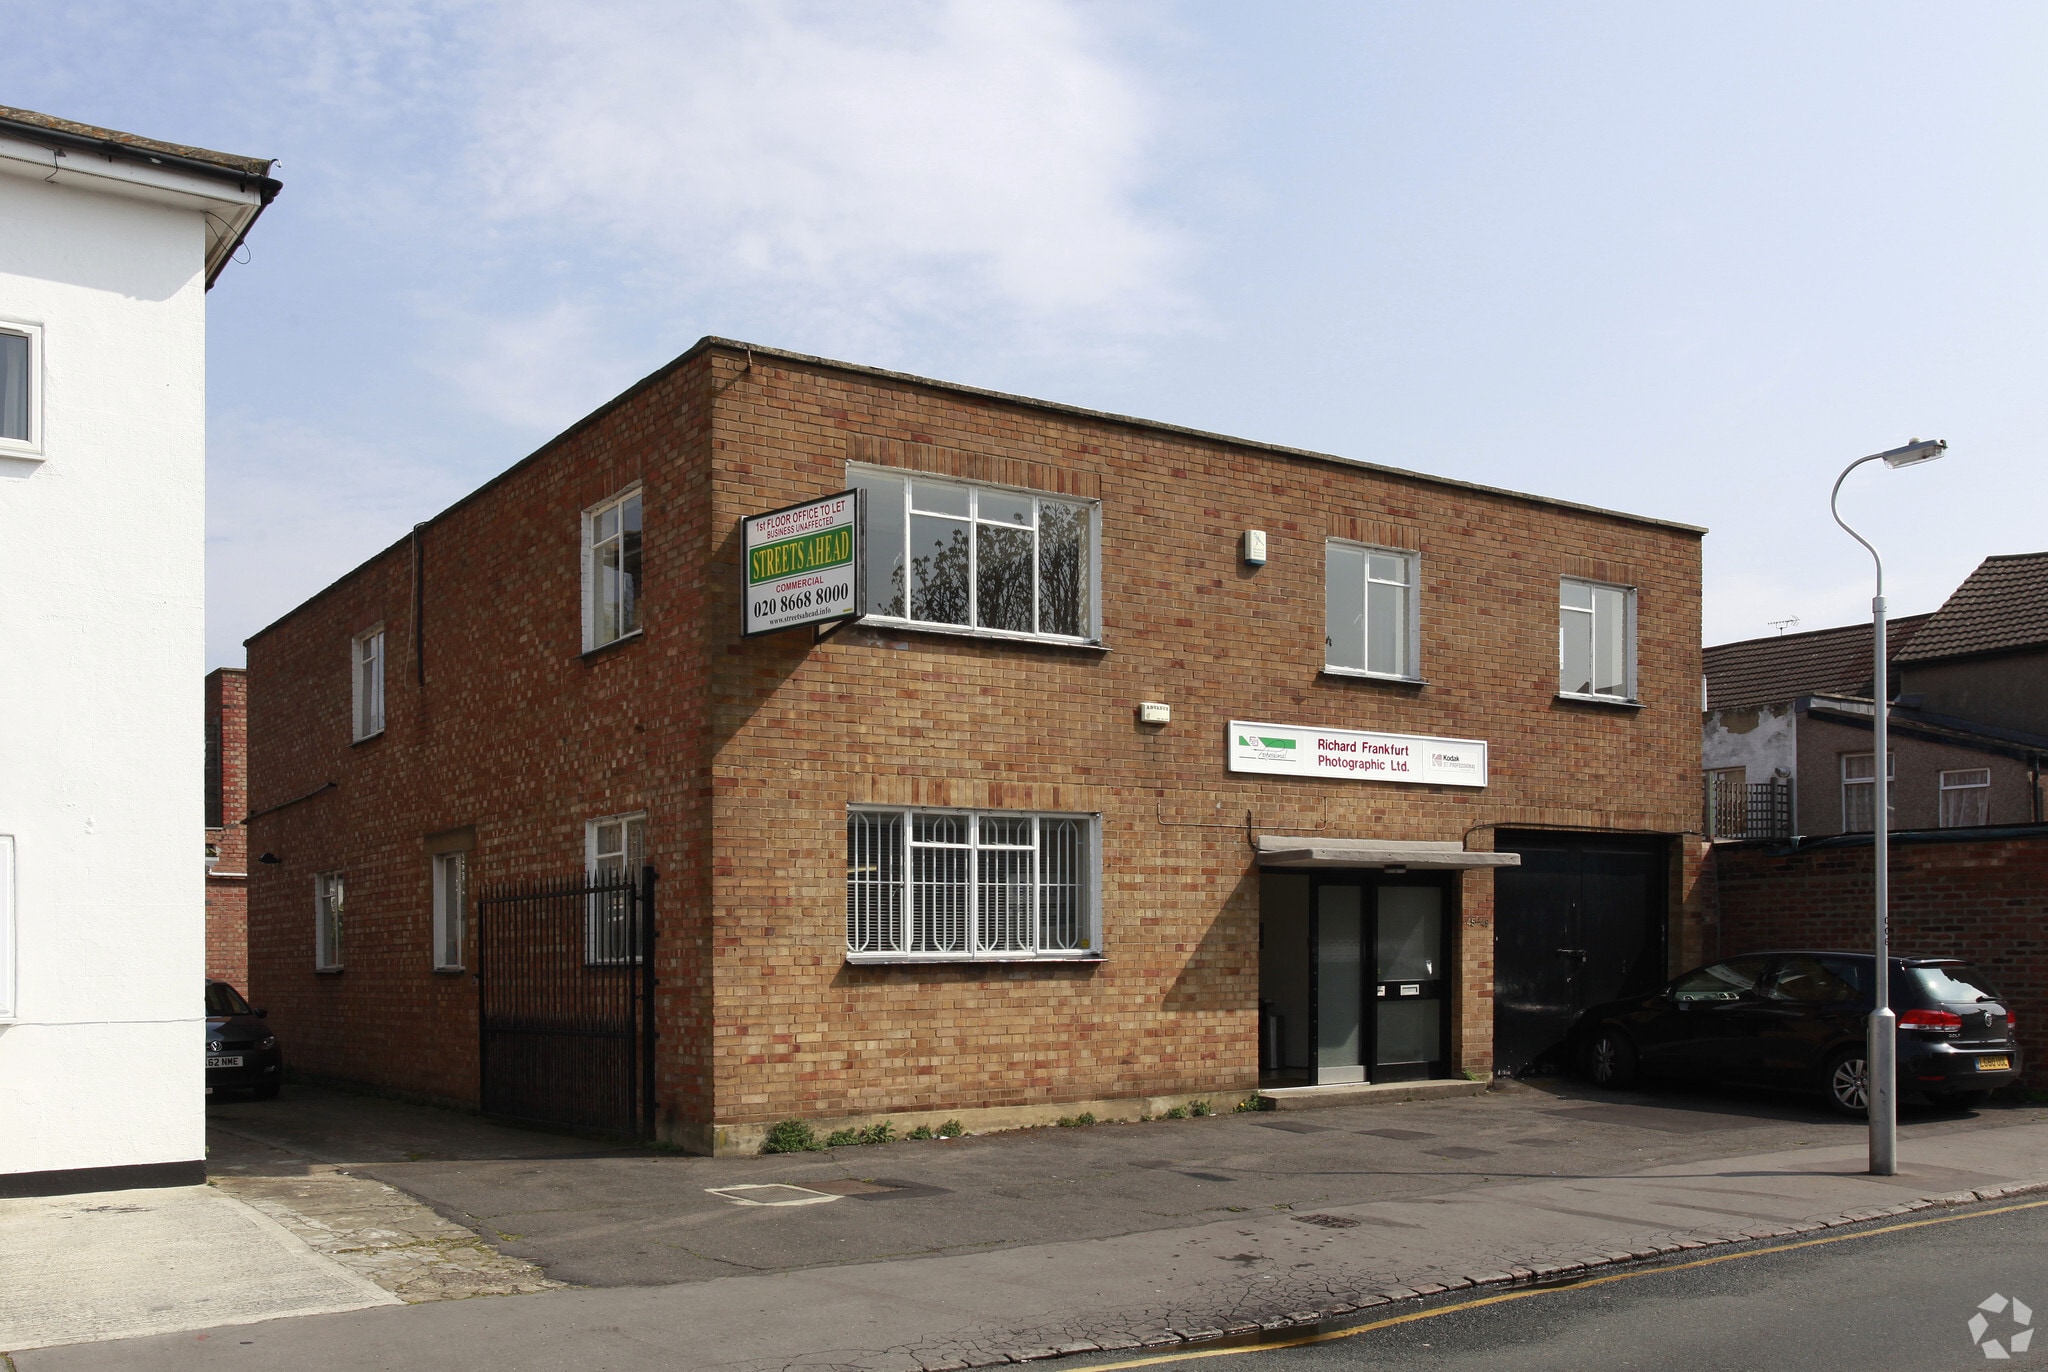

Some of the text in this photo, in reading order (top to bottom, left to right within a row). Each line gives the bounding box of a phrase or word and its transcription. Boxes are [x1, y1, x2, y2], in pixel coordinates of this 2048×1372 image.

[756, 500, 846, 533] 1st FLOOR OFFICE TO LET
[766, 516, 834, 539] BUSINESS UNAFFECTED
[753, 531, 849, 580] STREETS AHEAD
[775, 575, 824, 593] COMMERCIAL
[754, 582, 849, 618] 020 8668 8000
[769, 606, 832, 625] www.streetsahead.info
[1317, 738, 1410, 757] Richard Frankfurt
[1317, 755, 1410, 773] Photographic Ltd.
[1443, 754, 1460, 762] Kodak
[221, 1057, 239, 1066] NME
